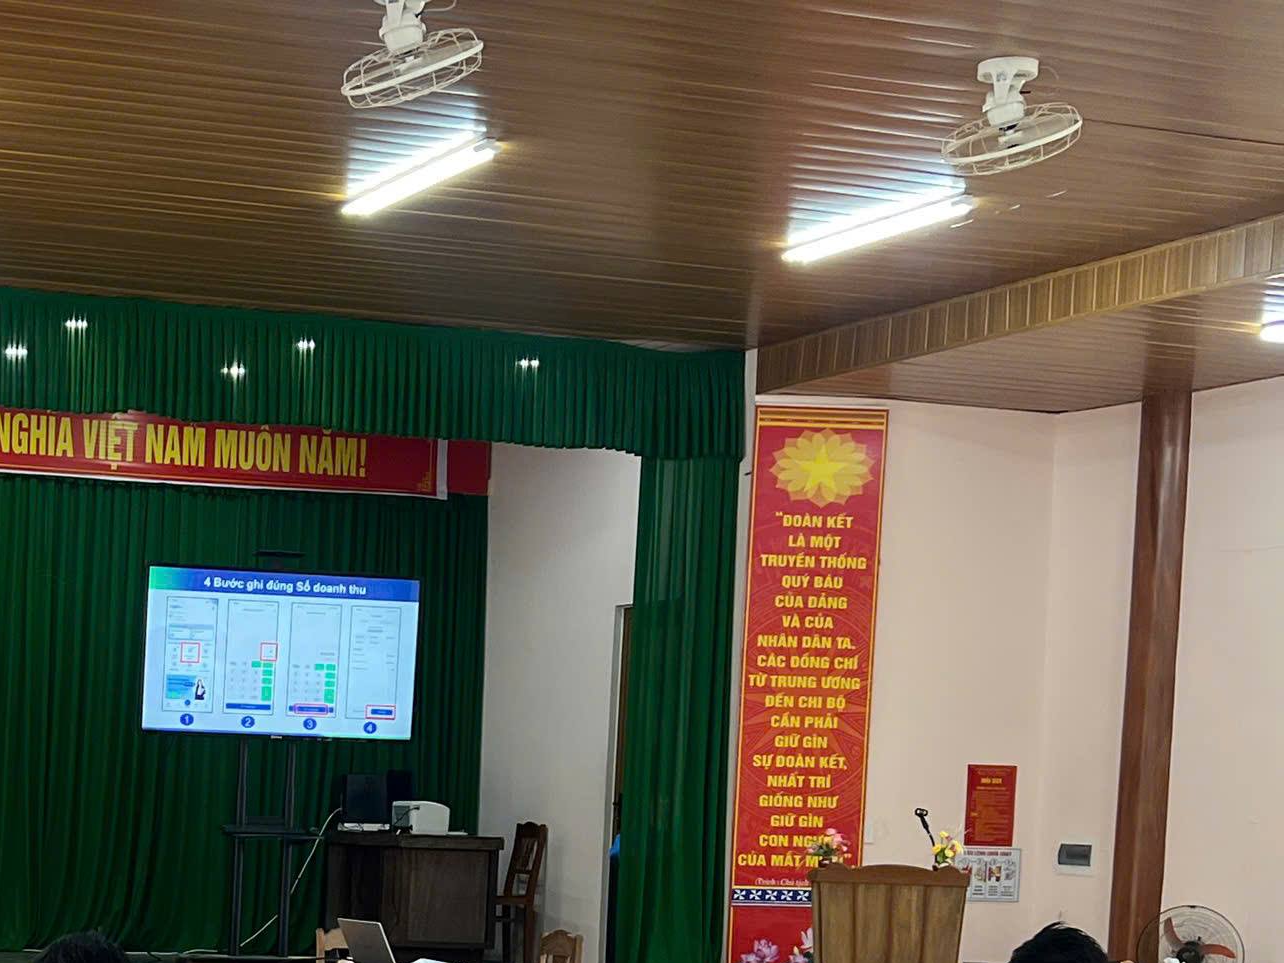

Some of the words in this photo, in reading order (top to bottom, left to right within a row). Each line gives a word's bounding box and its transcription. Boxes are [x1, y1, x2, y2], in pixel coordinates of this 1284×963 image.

[83, 412, 139, 471] VIỆT
[145, 423, 206, 467] NAM
[214, 424, 291, 473] MUÔN
[299, 428, 366, 478] NĂM!
[827, 512, 854, 529] KẾT
[788, 533, 806, 548] LÀ
[810, 533, 842, 551] MỘT
[204, 576, 211, 587] 4
[214, 577, 244, 589] Bước
[246, 579, 263, 592] ghi
[266, 580, 293, 593] đúng
[313, 582, 346, 594] doanh
[349, 584, 366, 595] thu
[782, 574, 809, 589] QUÝ
[775, 591, 804, 608] CỦA
[808, 593, 848, 609] ĐẢNG
[782, 613, 800, 628] VÀ
[805, 612, 834, 629] CỦA
[757, 633, 797, 648] NHÂN
[836, 637, 855, 649] TA.
[757, 653, 786, 667] CÁC
[834, 654, 859, 670] CHÍ
[770, 675, 817, 689] TRUNG
[821, 676, 860, 689] ƯƠNG
[798, 696, 822, 709] CHI
[804, 713, 838, 729] PHẢI
[775, 733, 801, 748] GIỮ
[803, 734, 828, 749] GÌN
[752, 754, 774, 770] SỰ
[776, 754, 815, 769] ĐOÀN
[767, 771, 805, 787] NHẤT
[809, 774, 831, 788] TRÍ
[759, 791, 803, 808] GIỐNG
[807, 795, 839, 809] NHƯ
[799, 812, 824, 828] GÌN
[759, 834, 788, 847] CON
[737, 850, 766, 866] CỦA
